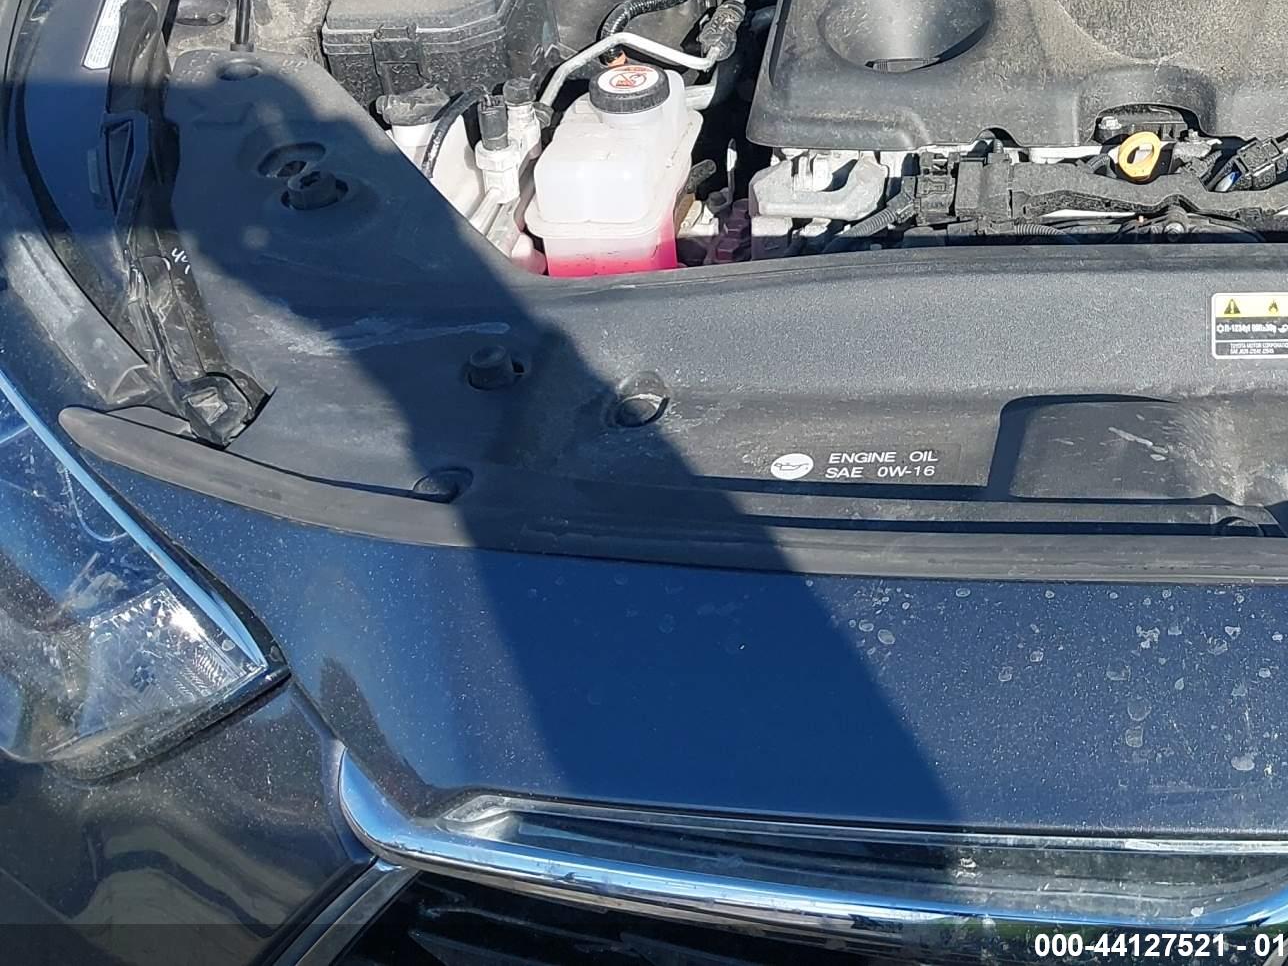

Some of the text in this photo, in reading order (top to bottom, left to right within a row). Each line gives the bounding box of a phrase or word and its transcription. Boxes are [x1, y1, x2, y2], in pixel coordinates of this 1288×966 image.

[828, 450, 938, 464] ENGINE OIL
[825, 465, 935, 479] SAE 0W-16
